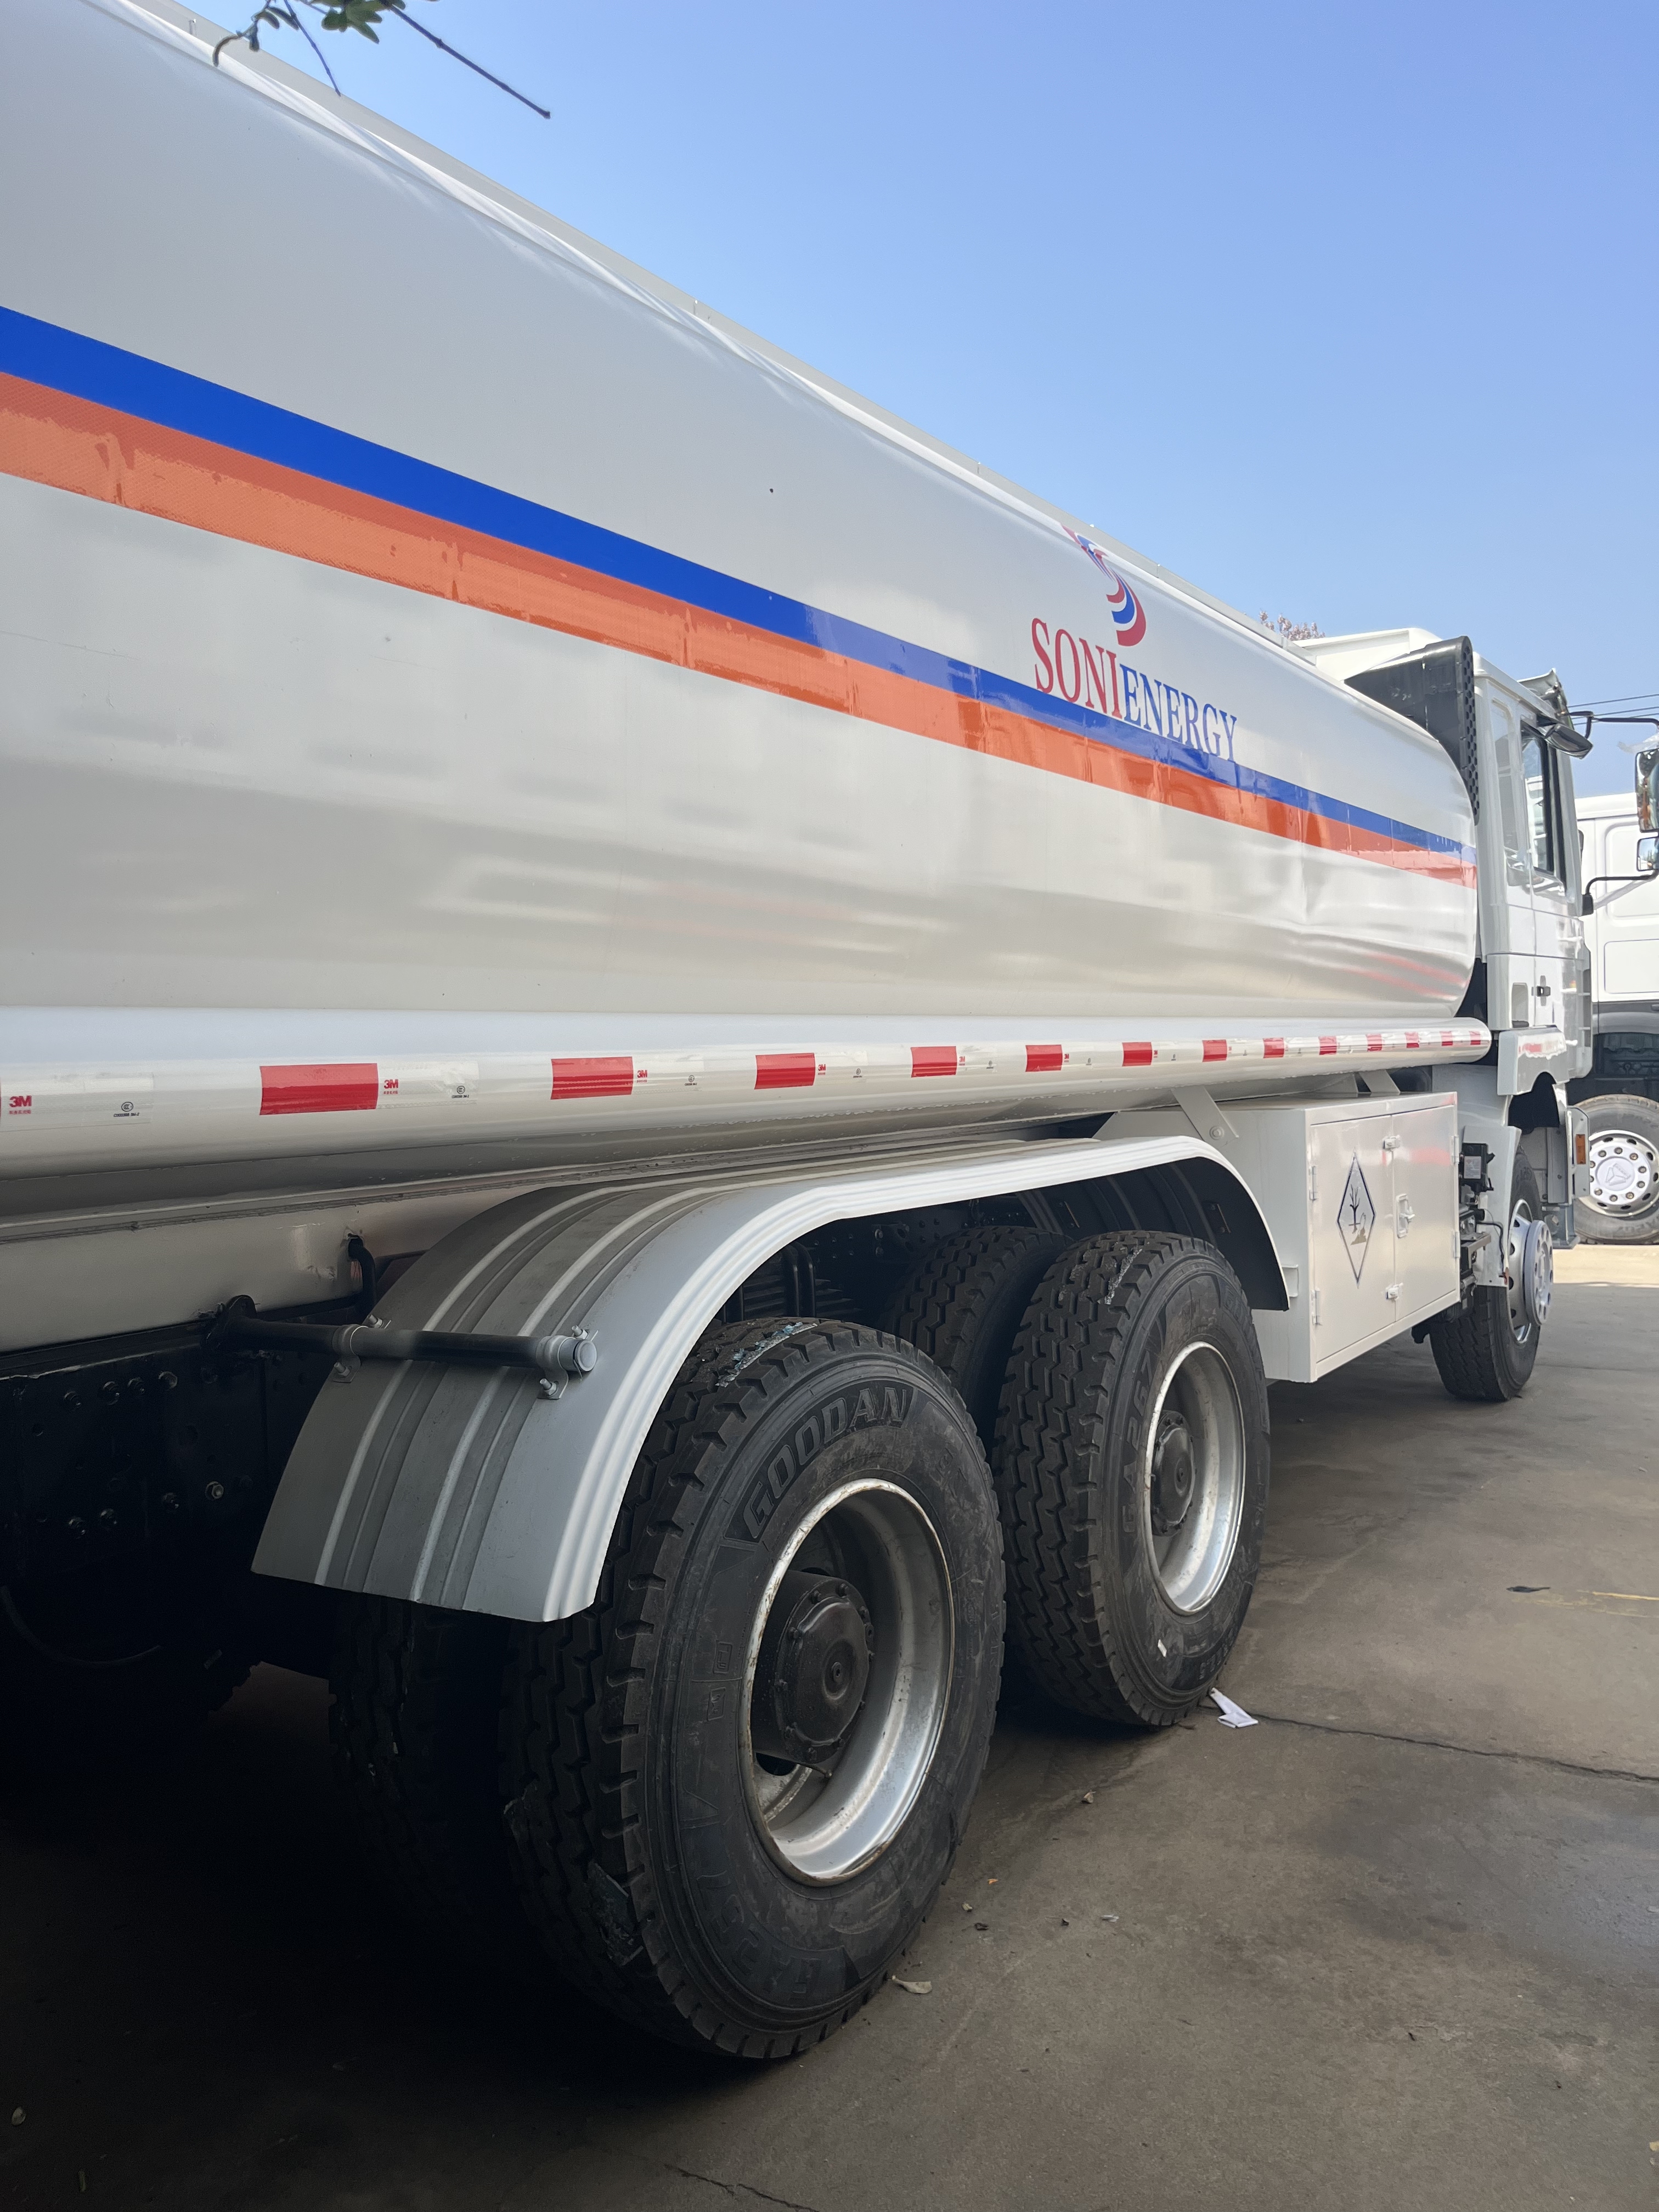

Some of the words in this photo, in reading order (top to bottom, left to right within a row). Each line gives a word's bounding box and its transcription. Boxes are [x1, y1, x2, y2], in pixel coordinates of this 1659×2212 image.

[637, 1069, 647, 1078] 3M
[383, 1079, 399, 1089] 3M
[9, 1095, 32, 1108] 3M
[742, 1386, 909, 1539] GOODAN
